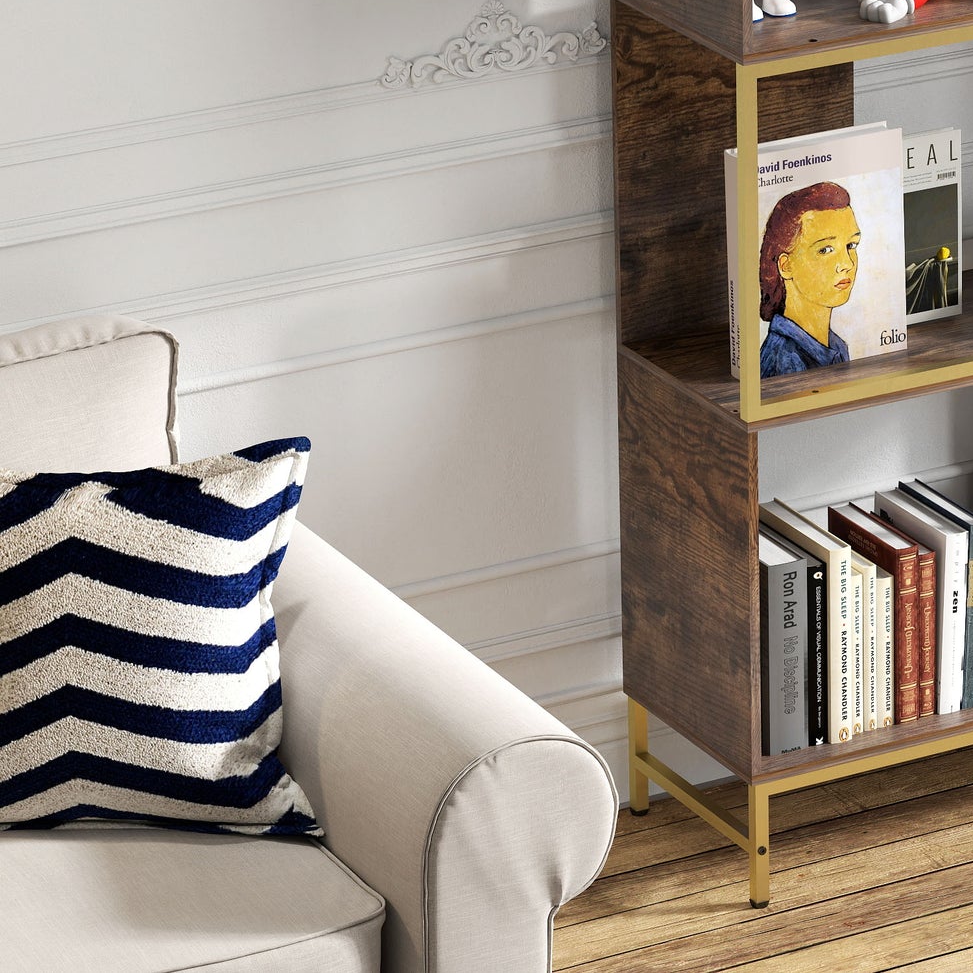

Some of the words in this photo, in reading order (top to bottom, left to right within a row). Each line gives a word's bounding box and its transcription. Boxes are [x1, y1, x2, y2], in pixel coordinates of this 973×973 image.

[782, 153, 832, 170] Foenkinos
[879, 328, 907, 347] folio
[783, 571, 797, 597] Ron
[783, 601, 798, 629] Arad
[783, 635, 799, 655] No
[780, 656, 799, 715] Discipline
